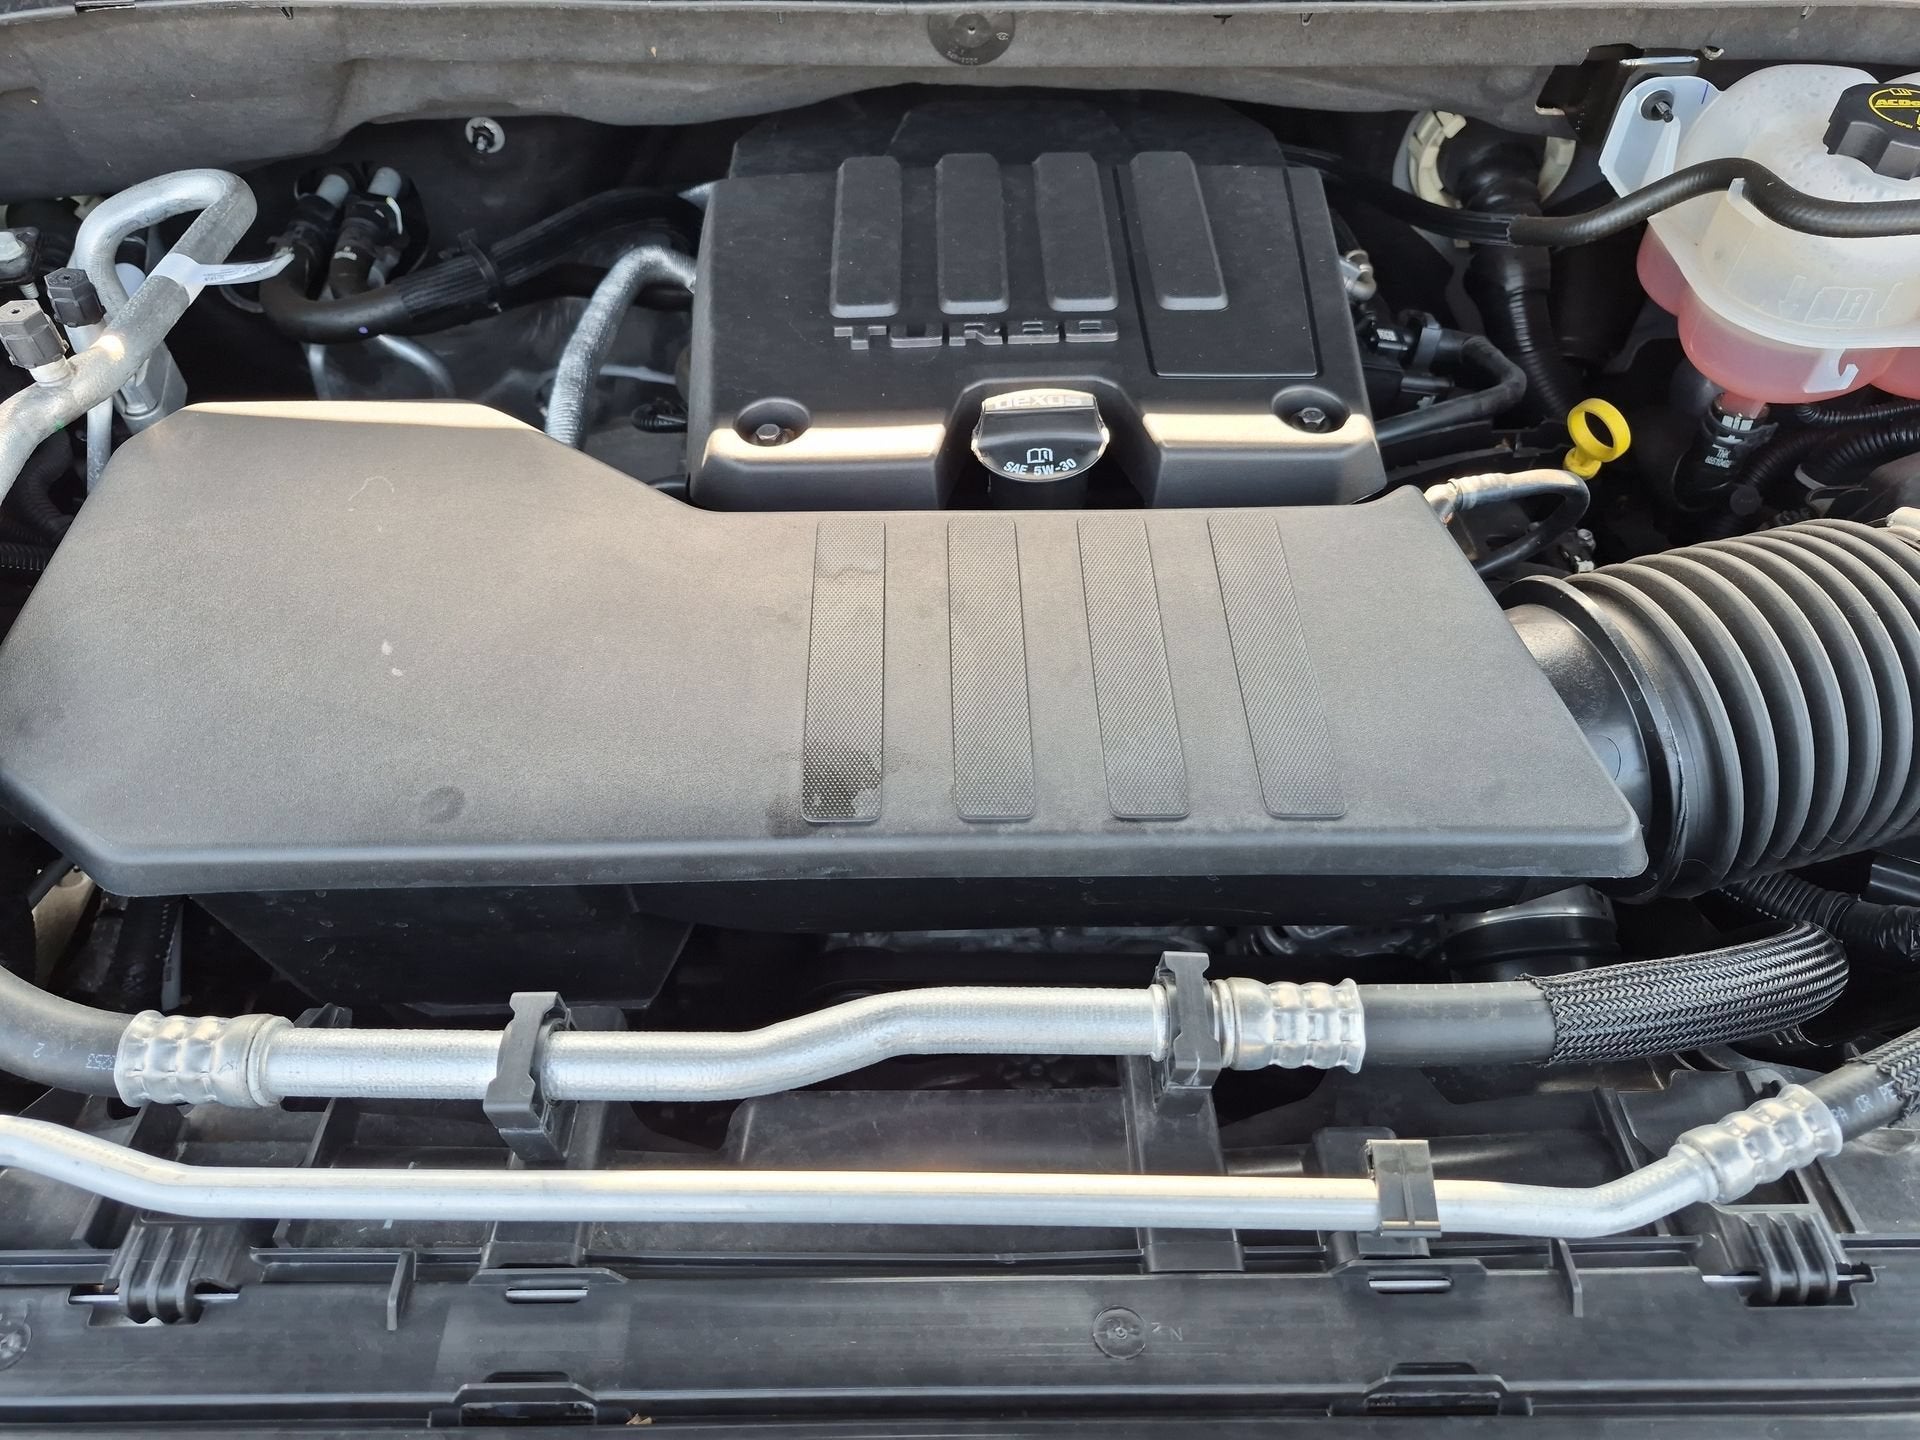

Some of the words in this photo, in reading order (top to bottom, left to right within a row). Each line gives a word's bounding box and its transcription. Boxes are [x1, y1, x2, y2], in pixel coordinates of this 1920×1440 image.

[834, 319, 1119, 350] TURBO
[1003, 461, 1028, 475] SAE
[1033, 458, 1077, 477] 5W-30
